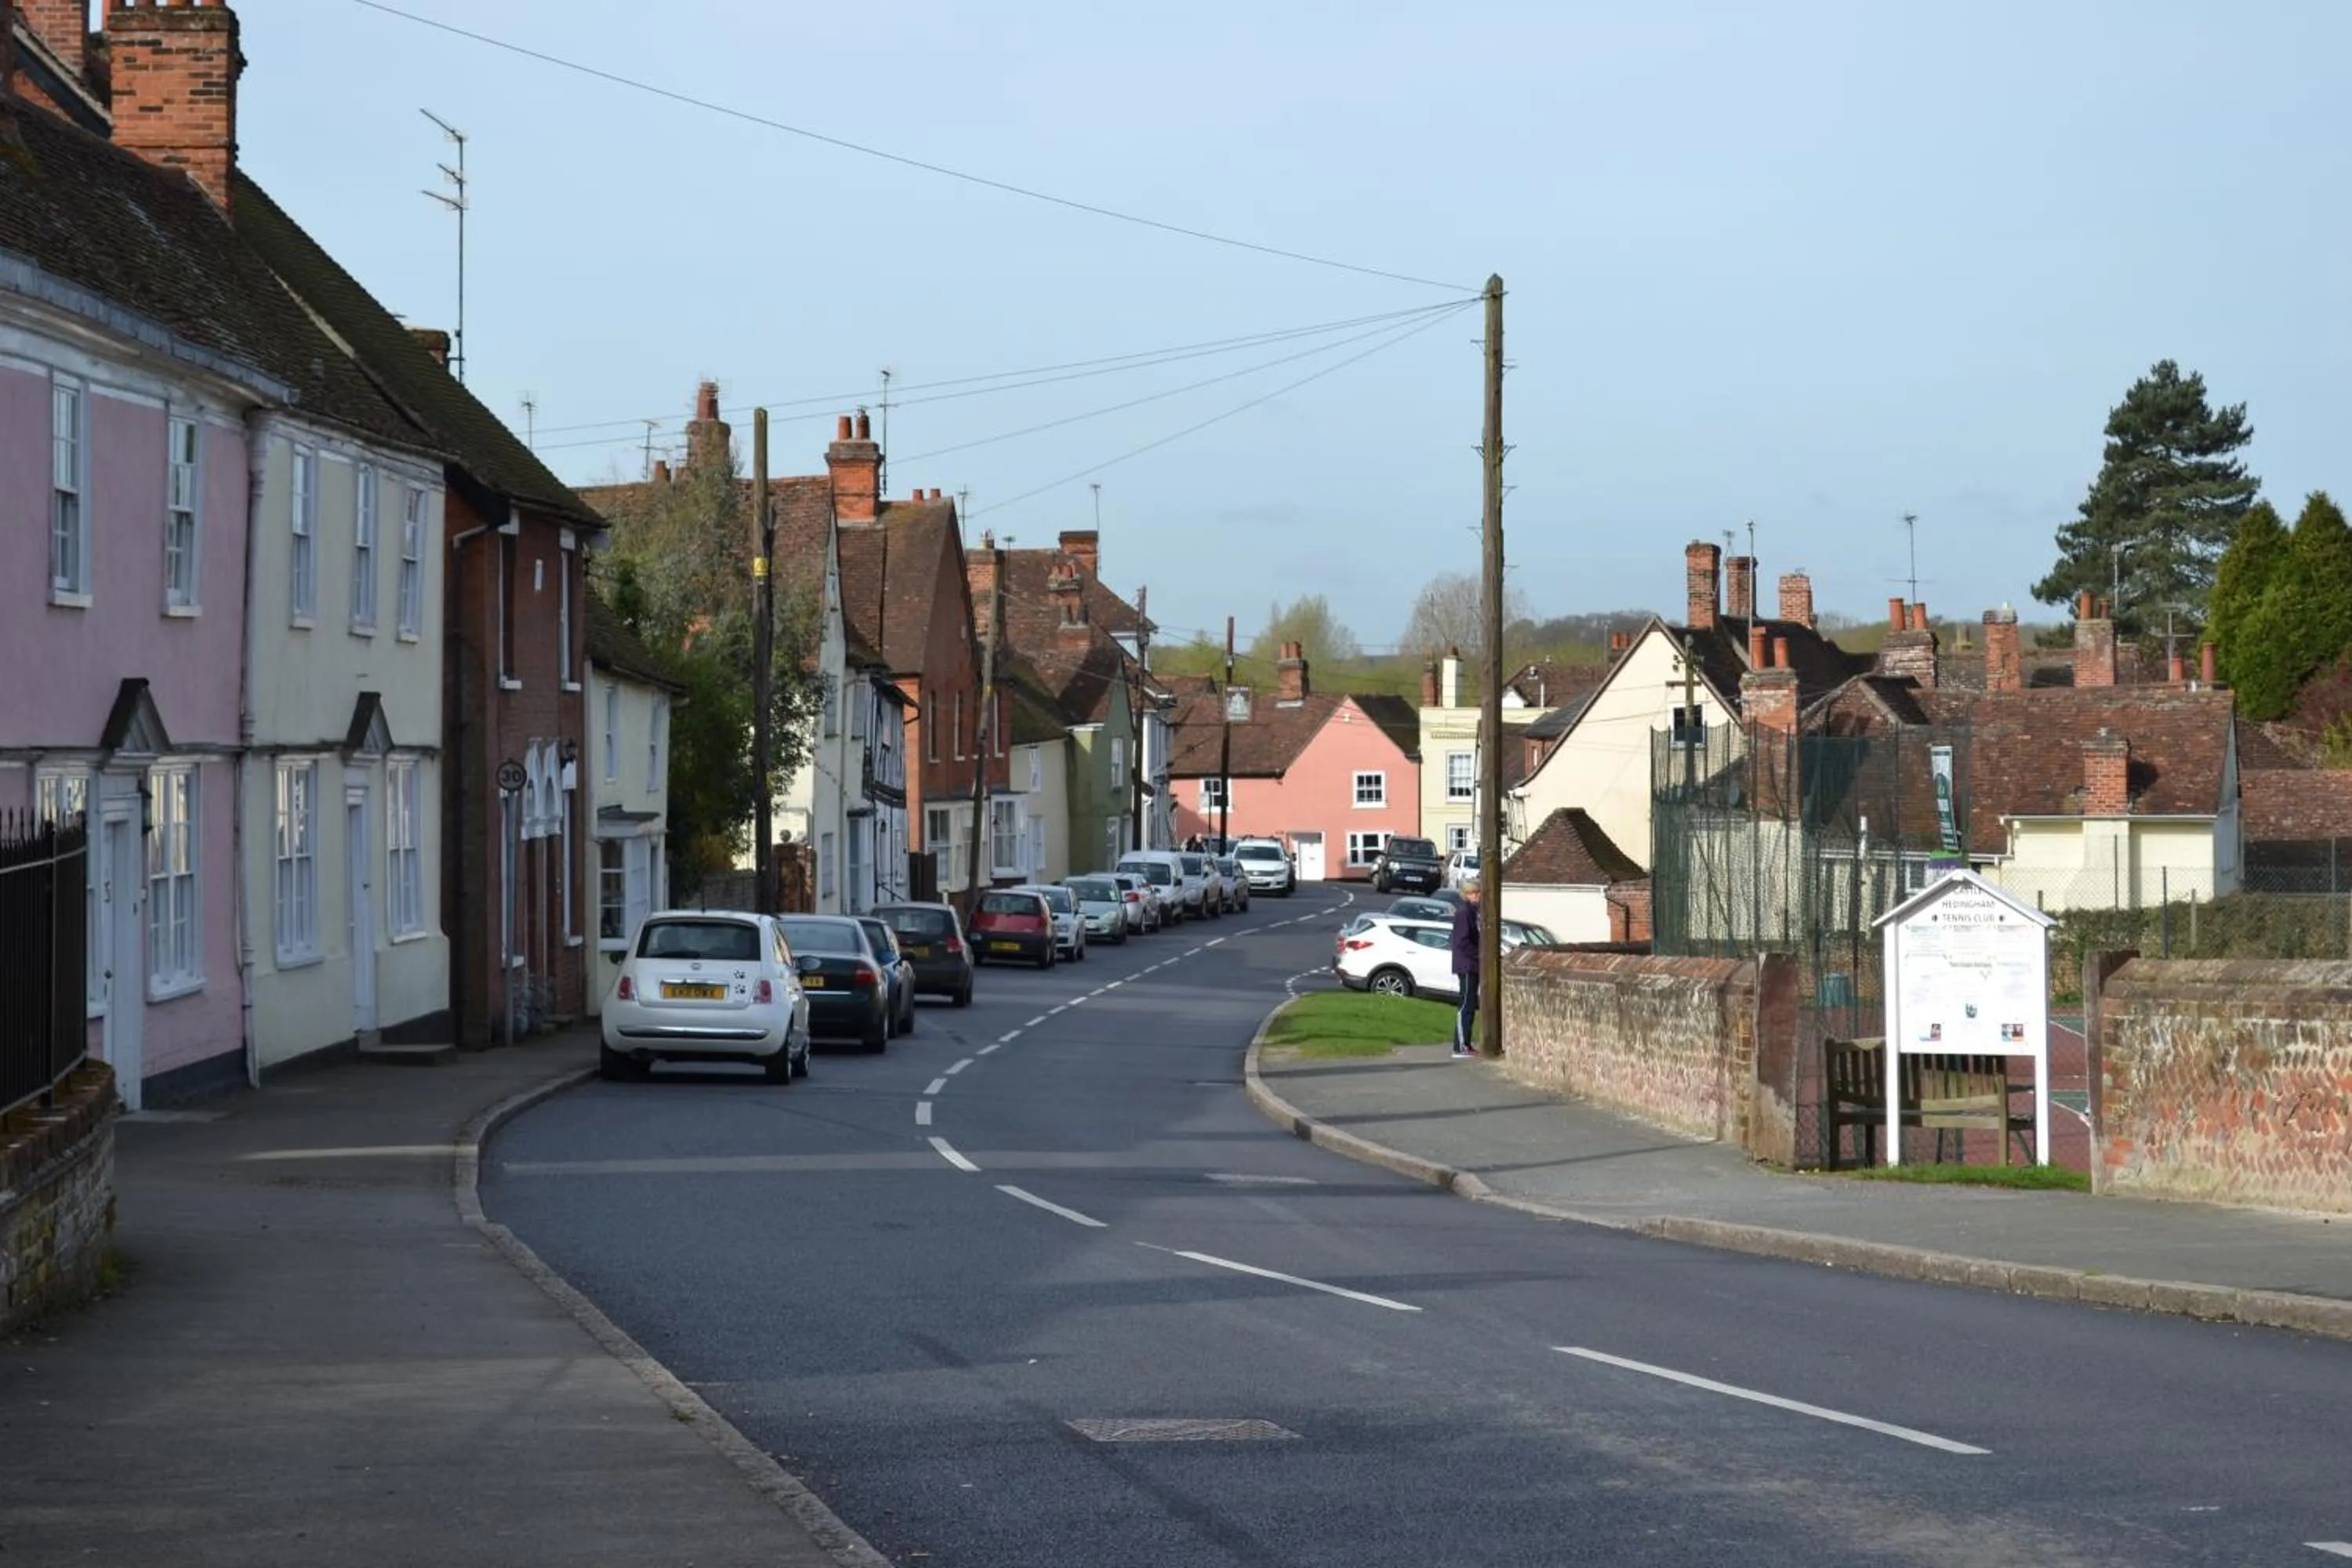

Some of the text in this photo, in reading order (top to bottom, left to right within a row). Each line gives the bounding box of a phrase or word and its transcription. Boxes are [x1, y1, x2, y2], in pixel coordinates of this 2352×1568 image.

[501, 769, 522, 782] 30
[1942, 899, 1995, 909] HEDINGHAM
[1942, 913, 1995, 923] TENNIS CLUB
